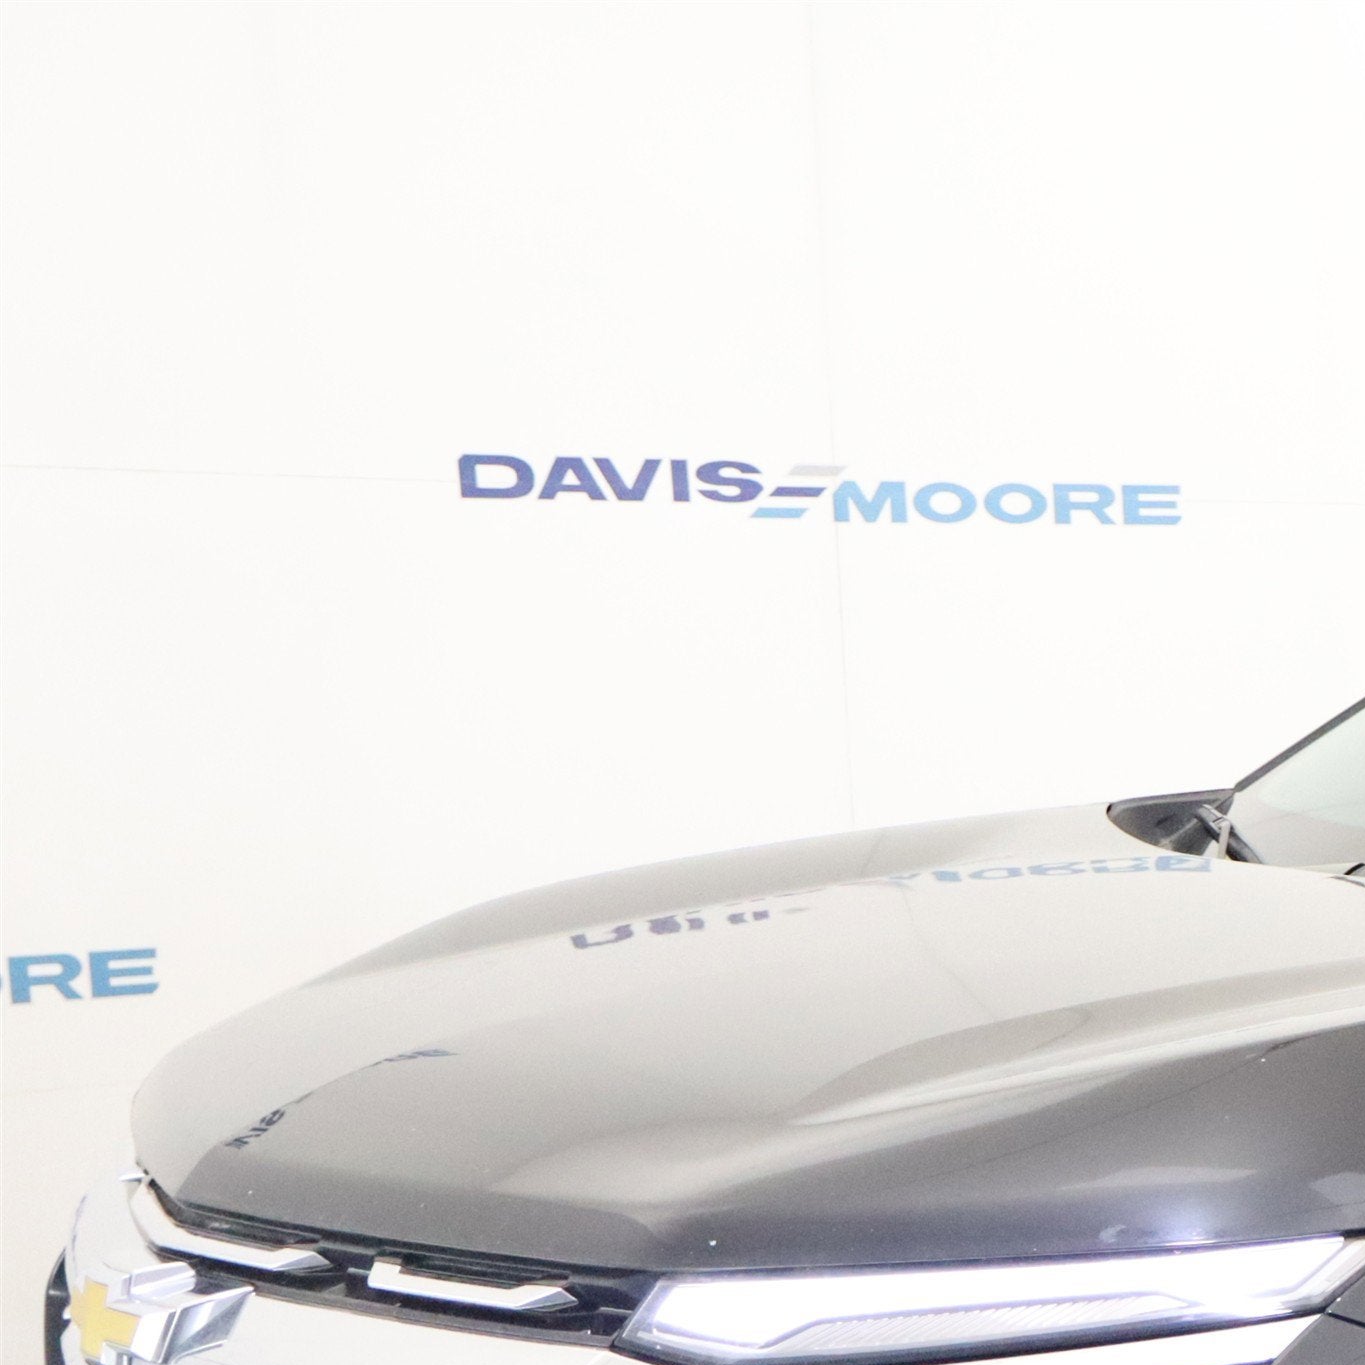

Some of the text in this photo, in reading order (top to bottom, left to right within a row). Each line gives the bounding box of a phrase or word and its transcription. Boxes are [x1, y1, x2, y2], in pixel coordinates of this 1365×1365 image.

[458, 454, 1182, 525] DAVIS MOORE
[0, 948, 160, 1004] RE
